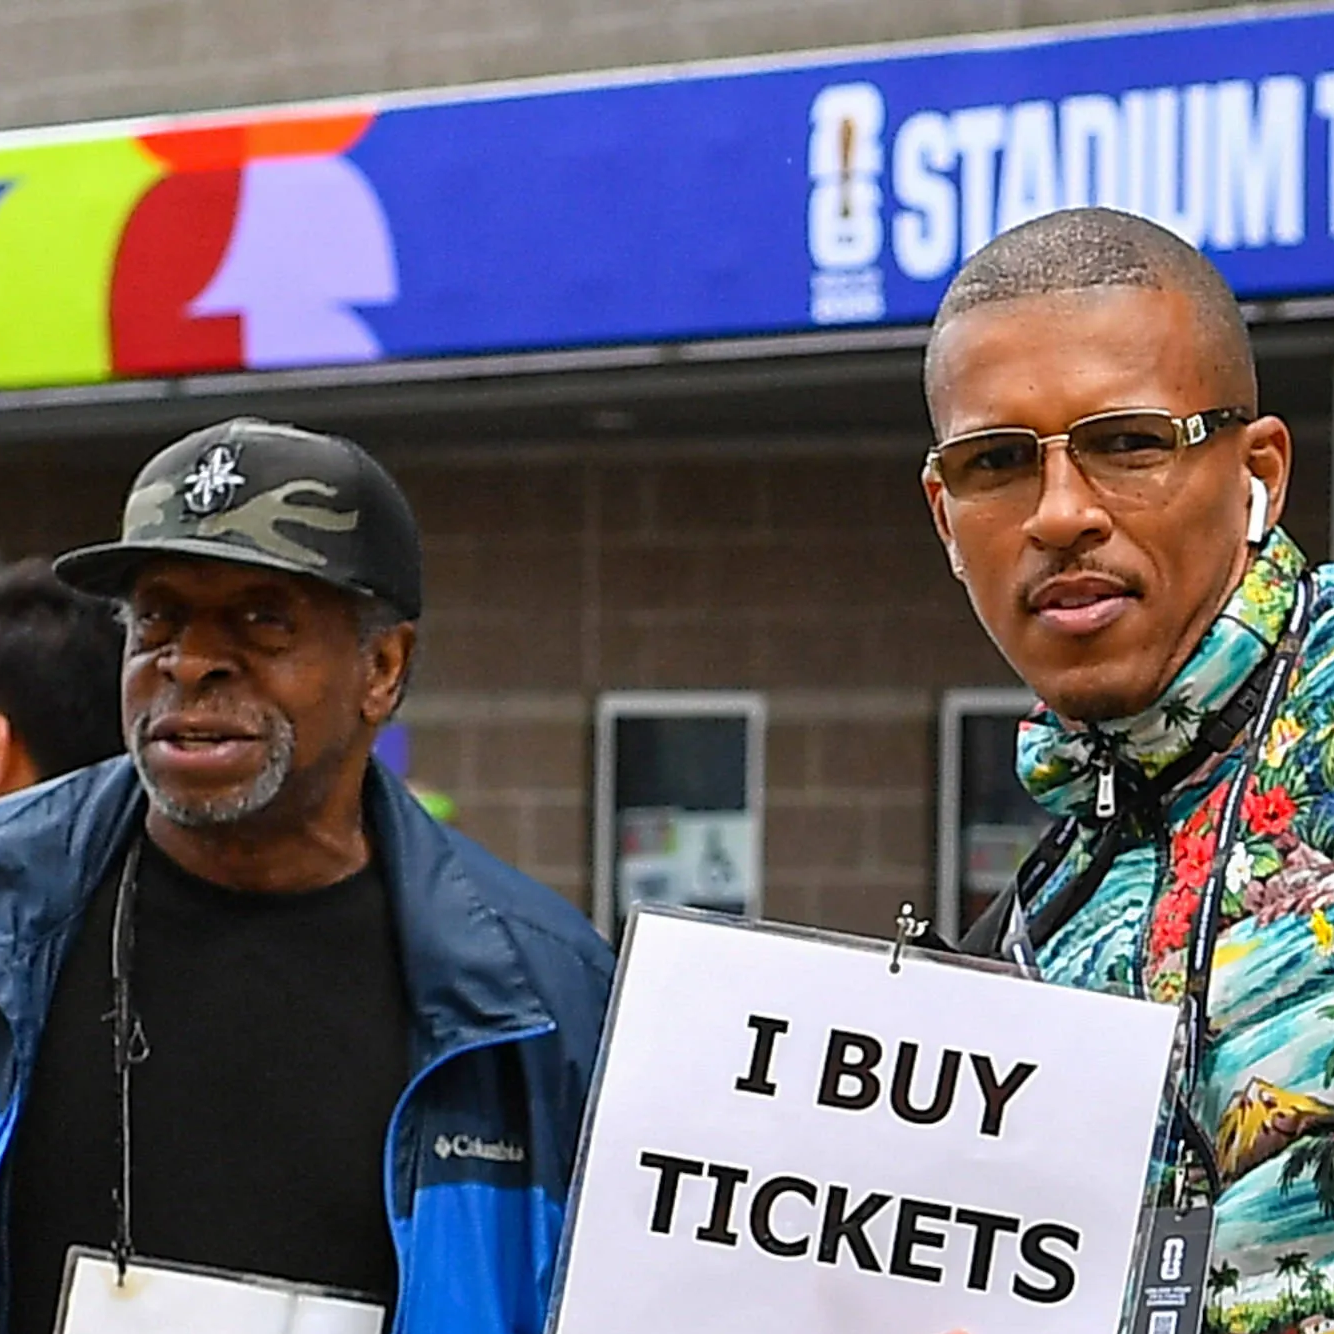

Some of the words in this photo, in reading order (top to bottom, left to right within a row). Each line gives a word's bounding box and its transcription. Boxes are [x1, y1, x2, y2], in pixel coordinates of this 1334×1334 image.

[892, 76, 1305, 280] STADIUM
[735, 1015, 789, 1097] I
[816, 1028, 1038, 1138] BUY
[452, 1134, 524, 1162] Columbia
[639, 1151, 1082, 1303] TICKETS
